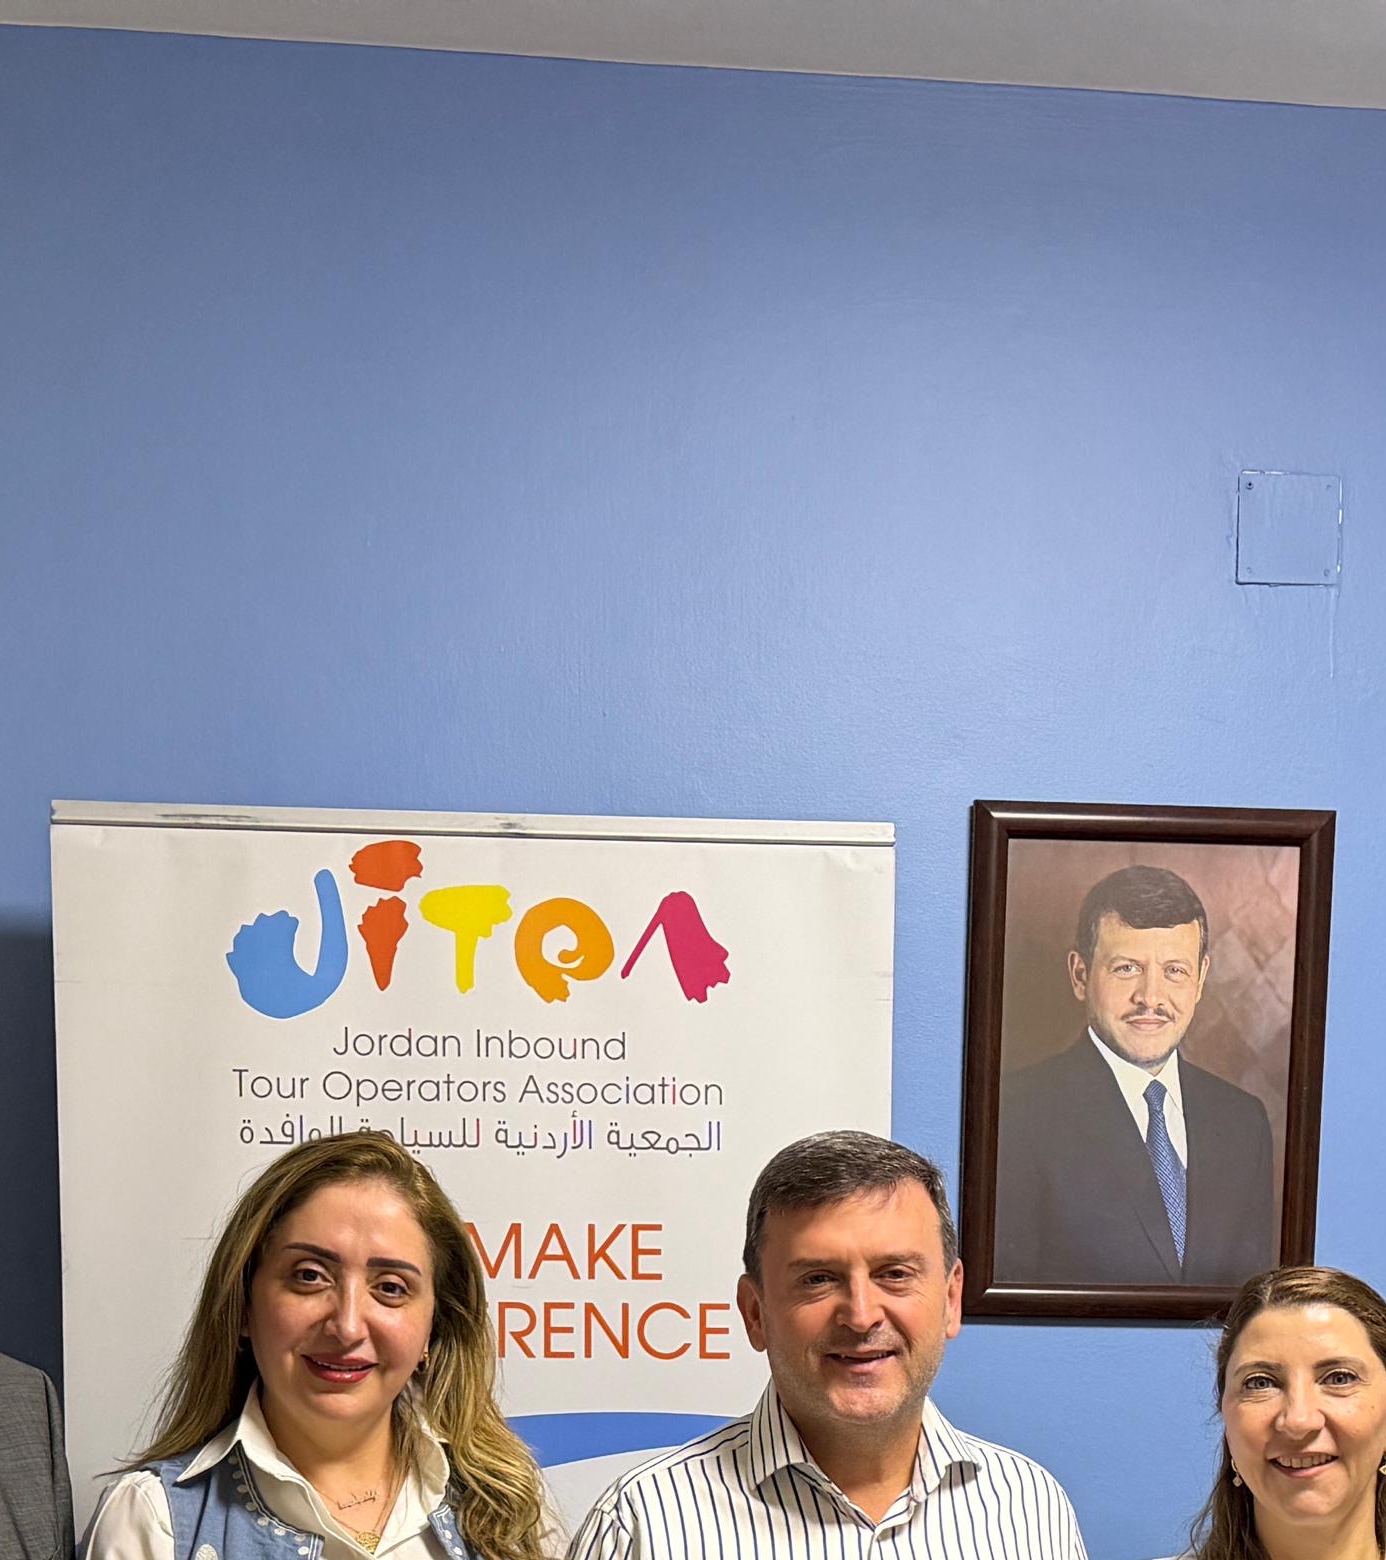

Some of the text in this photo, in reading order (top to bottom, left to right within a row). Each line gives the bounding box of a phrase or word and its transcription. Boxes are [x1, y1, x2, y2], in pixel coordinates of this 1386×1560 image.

[333, 1026, 626, 1060] Jordan Inbound
[232, 1068, 723, 1107] Tour Operators Association
[494, 1110, 593, 1159] الأردنية
[607, 1120, 721, 1158] الجمعية
[464, 1222, 663, 1281] MAKE
